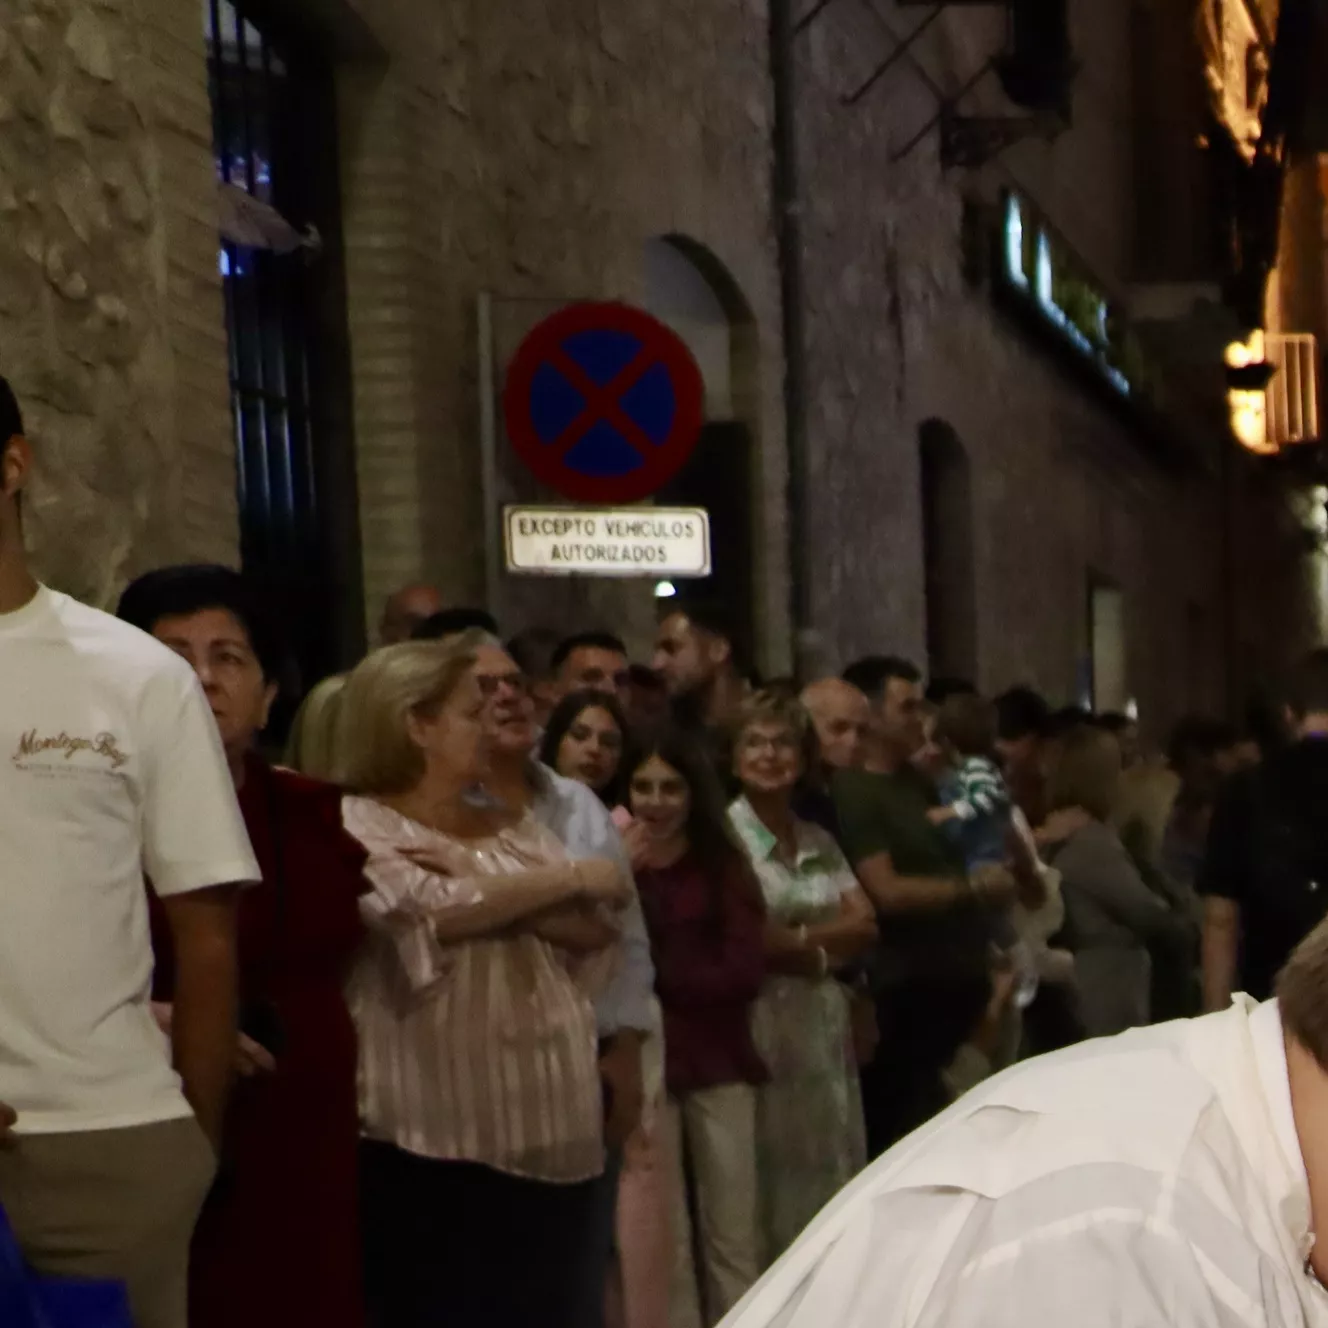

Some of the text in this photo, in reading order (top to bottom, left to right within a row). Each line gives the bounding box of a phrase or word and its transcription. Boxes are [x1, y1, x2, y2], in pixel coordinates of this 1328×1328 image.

[518, 517, 694, 538] EXCEPTO VEHICULOS
[550, 543, 668, 563] AUTORIZADOS
